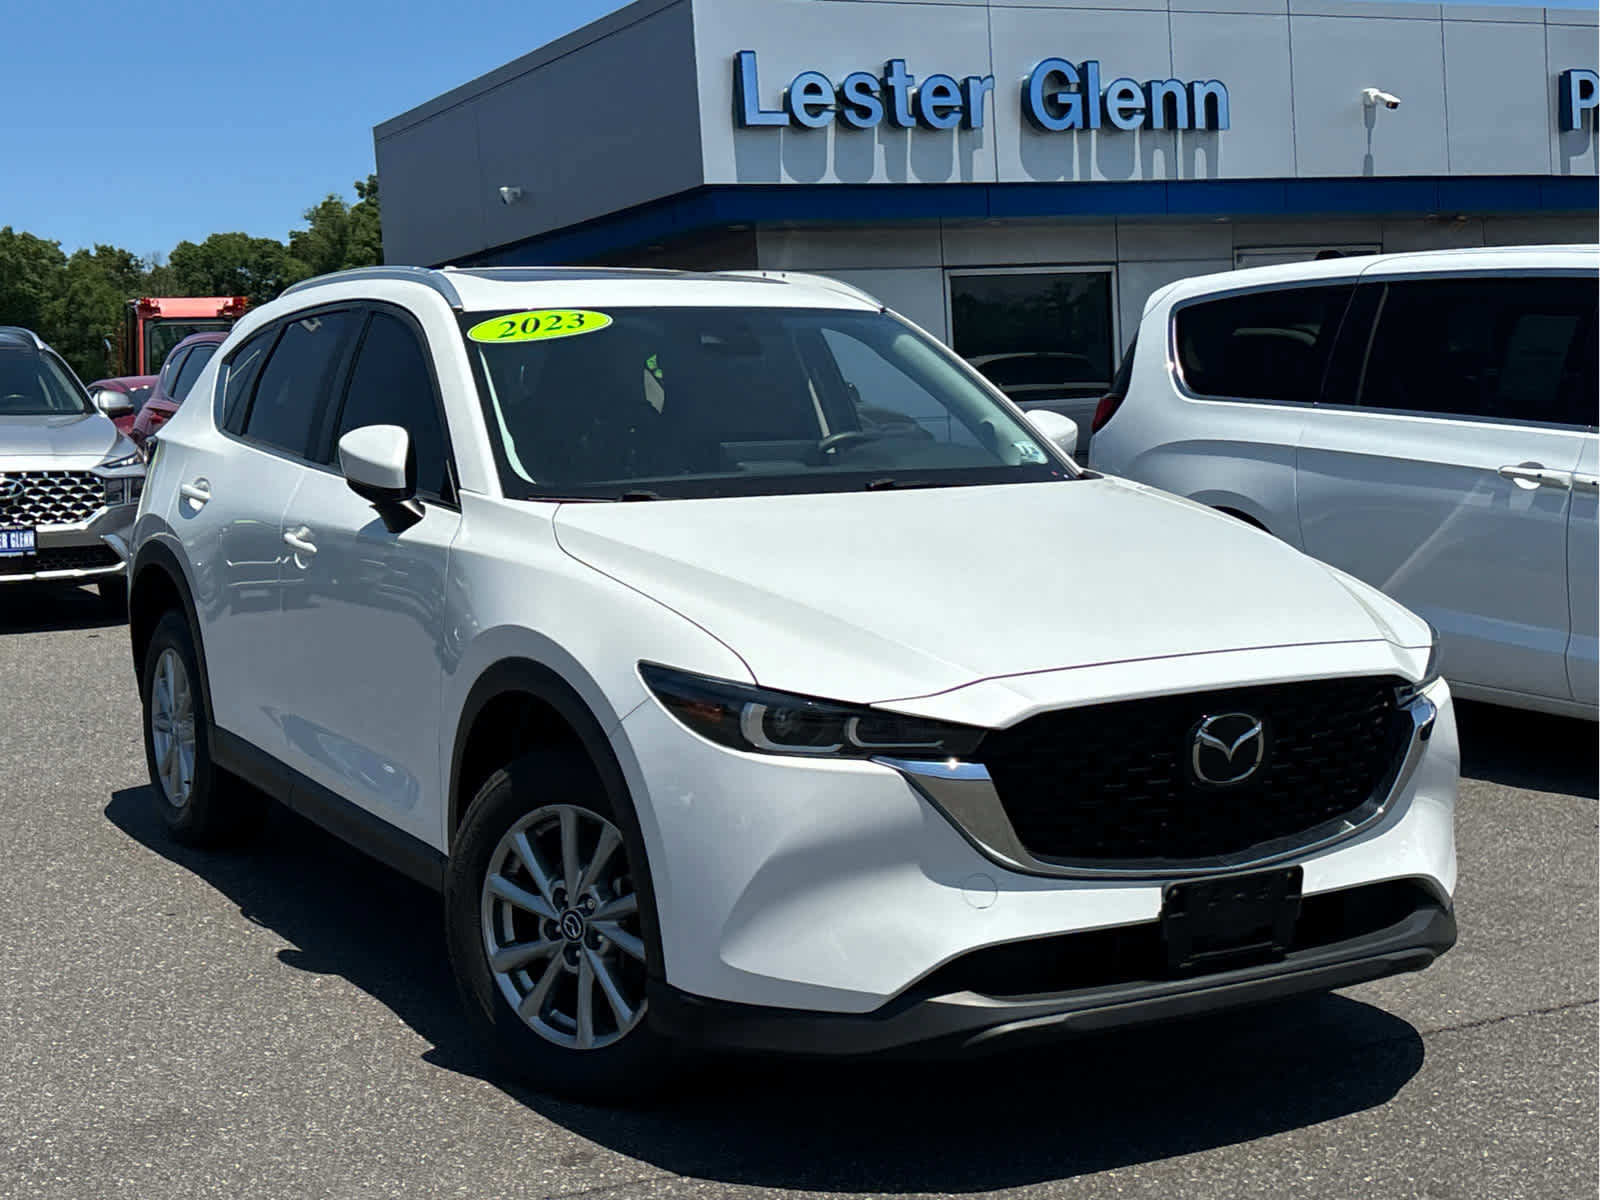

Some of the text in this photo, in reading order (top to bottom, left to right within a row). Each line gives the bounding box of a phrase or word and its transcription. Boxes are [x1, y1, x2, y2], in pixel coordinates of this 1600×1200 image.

[735, 50, 994, 129] Lester
[1023, 57, 1230, 132] Glenn
[497, 312, 585, 339] 2023
